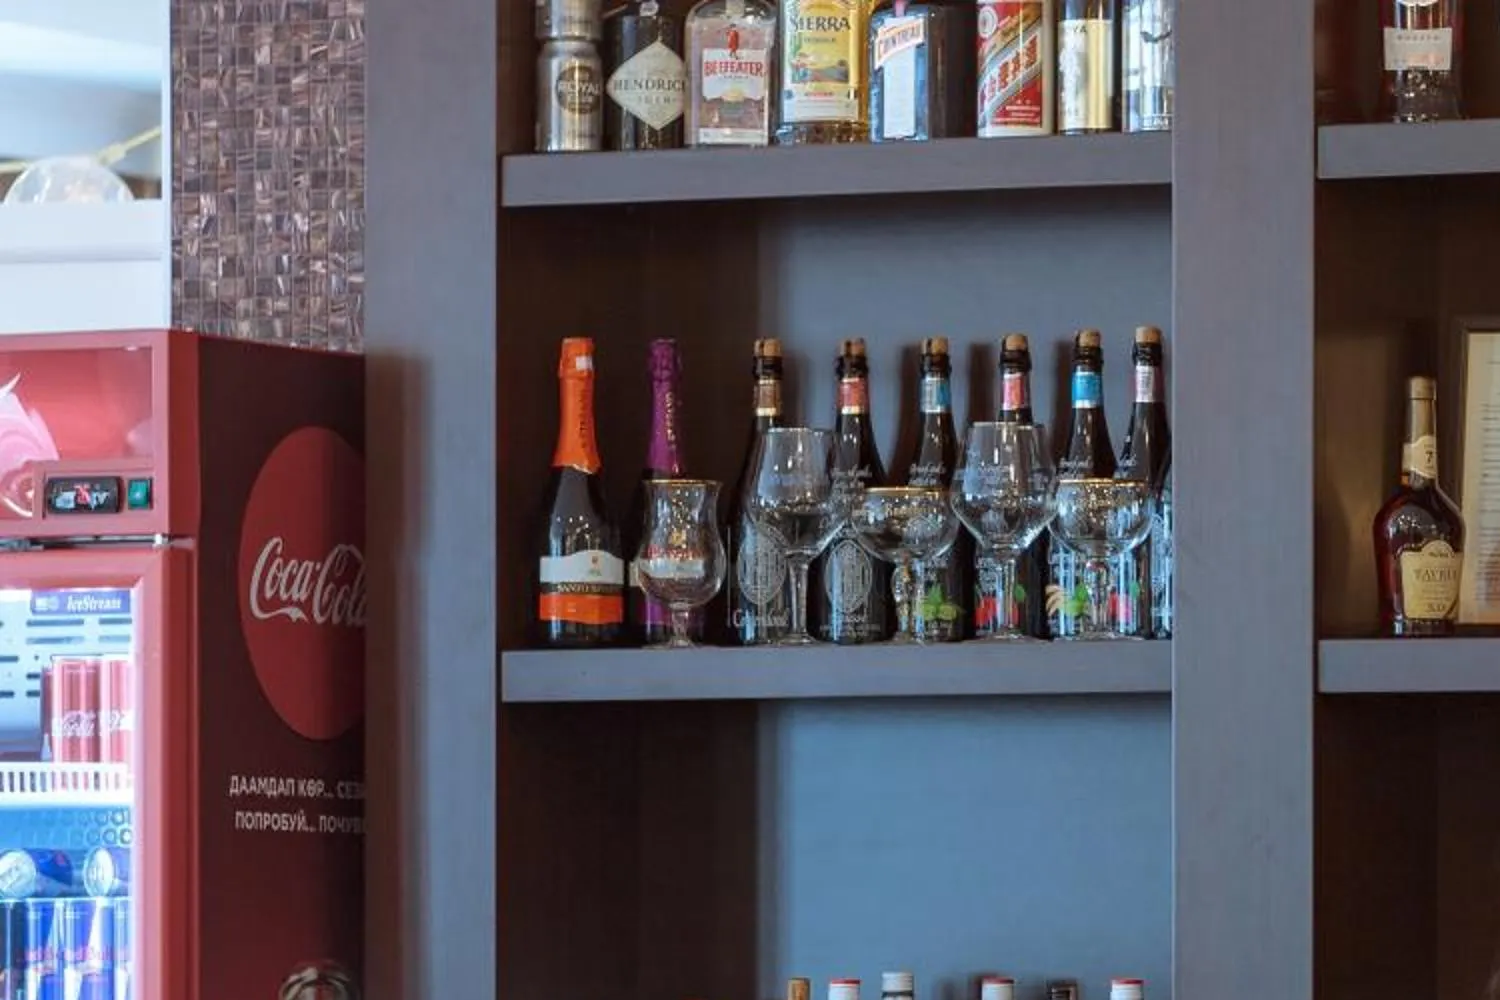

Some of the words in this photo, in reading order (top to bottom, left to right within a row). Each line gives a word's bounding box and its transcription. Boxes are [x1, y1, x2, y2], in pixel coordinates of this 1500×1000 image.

[789, 15, 851, 32] SIERRA
[704, 61, 764, 77] BEEFEATER
[229, 775, 295, 798] ДААМДАП
[319, 815, 365, 834] ПОЧУВ
